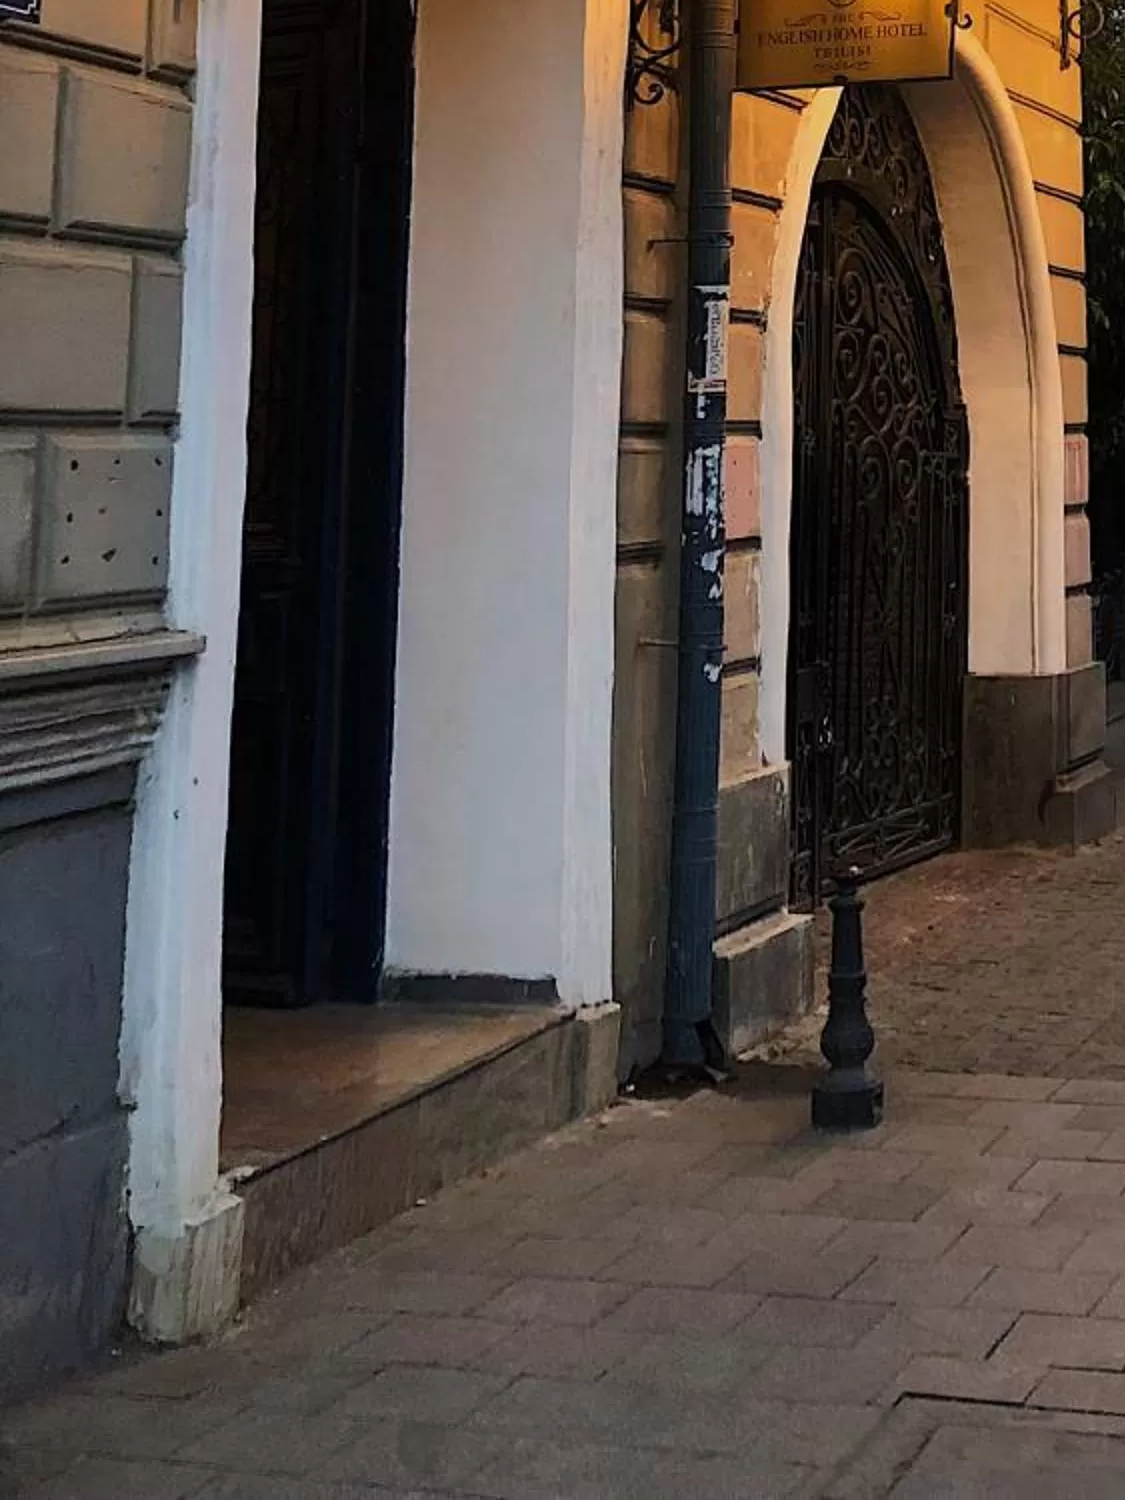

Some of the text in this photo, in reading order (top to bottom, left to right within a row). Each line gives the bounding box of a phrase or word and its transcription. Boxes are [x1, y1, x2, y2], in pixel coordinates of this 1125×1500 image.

[757, 22, 928, 47] ENGLISH HOME HOTEL
